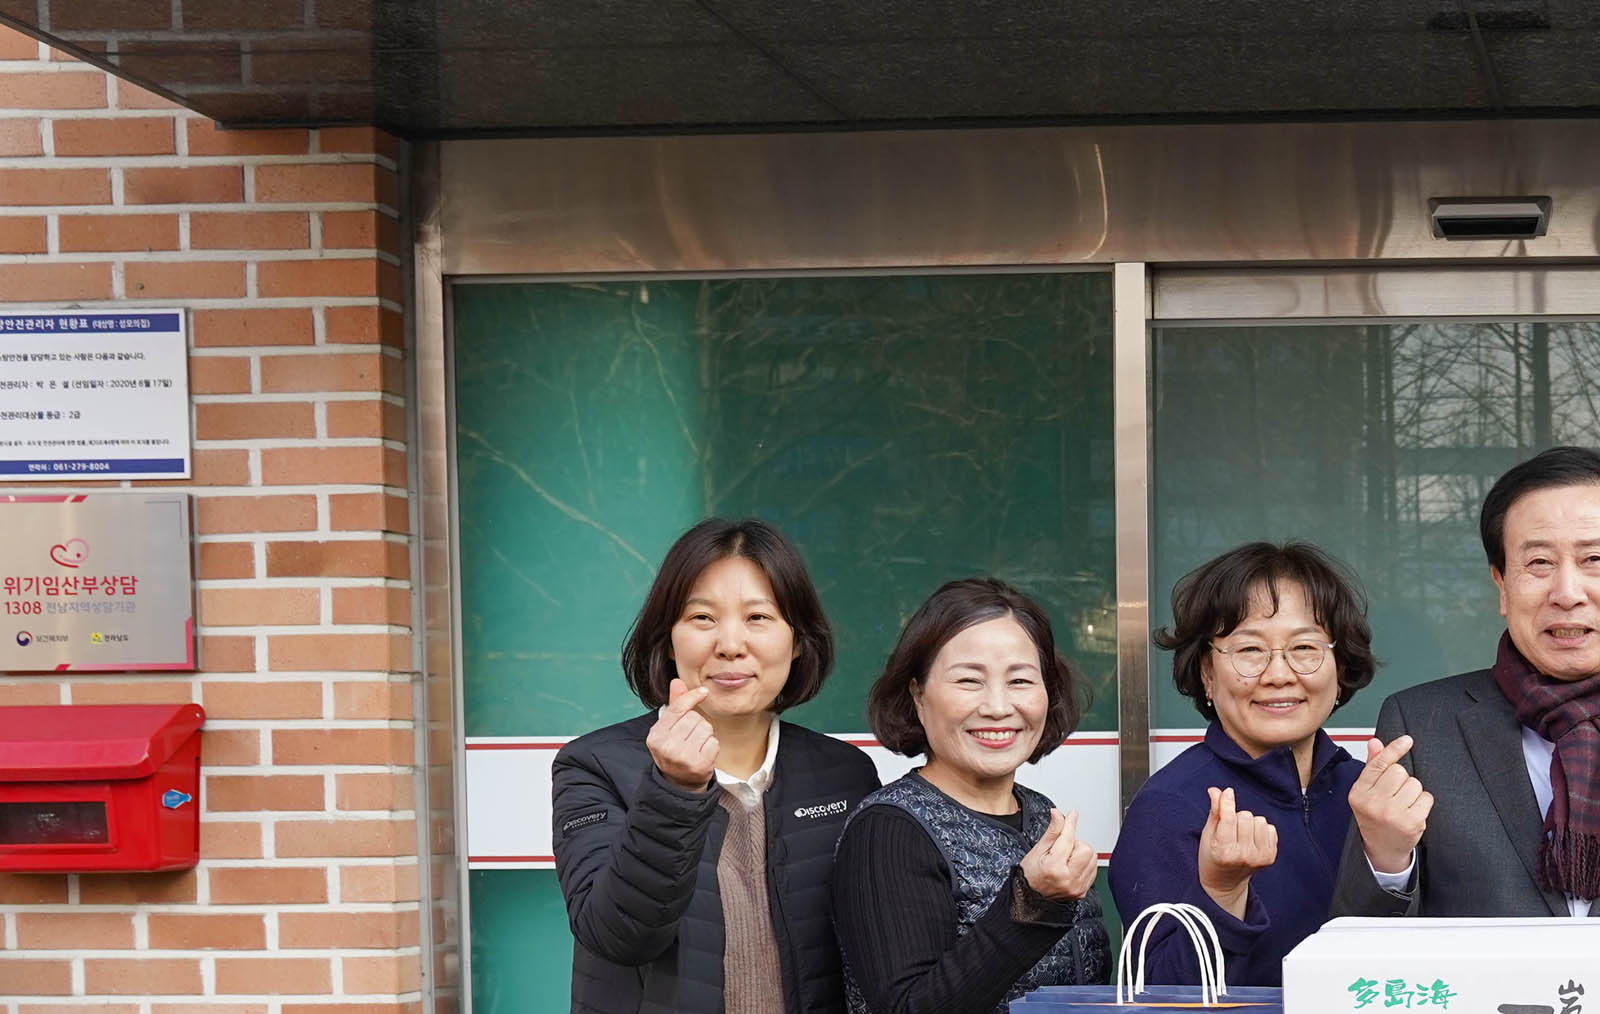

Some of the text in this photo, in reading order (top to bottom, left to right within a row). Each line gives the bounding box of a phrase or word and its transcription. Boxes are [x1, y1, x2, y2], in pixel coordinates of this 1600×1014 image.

[0, 353, 28, 362] 방안전을
[0, 411, 44, 420] 전관리대상물
[68, 411, 80, 420] 2급
[4, 576, 139, 596] 위기임산부상담
[5, 601, 136, 615] 1308 전남지역상담기관
[1347, 977, 1457, 1010] 多島海
